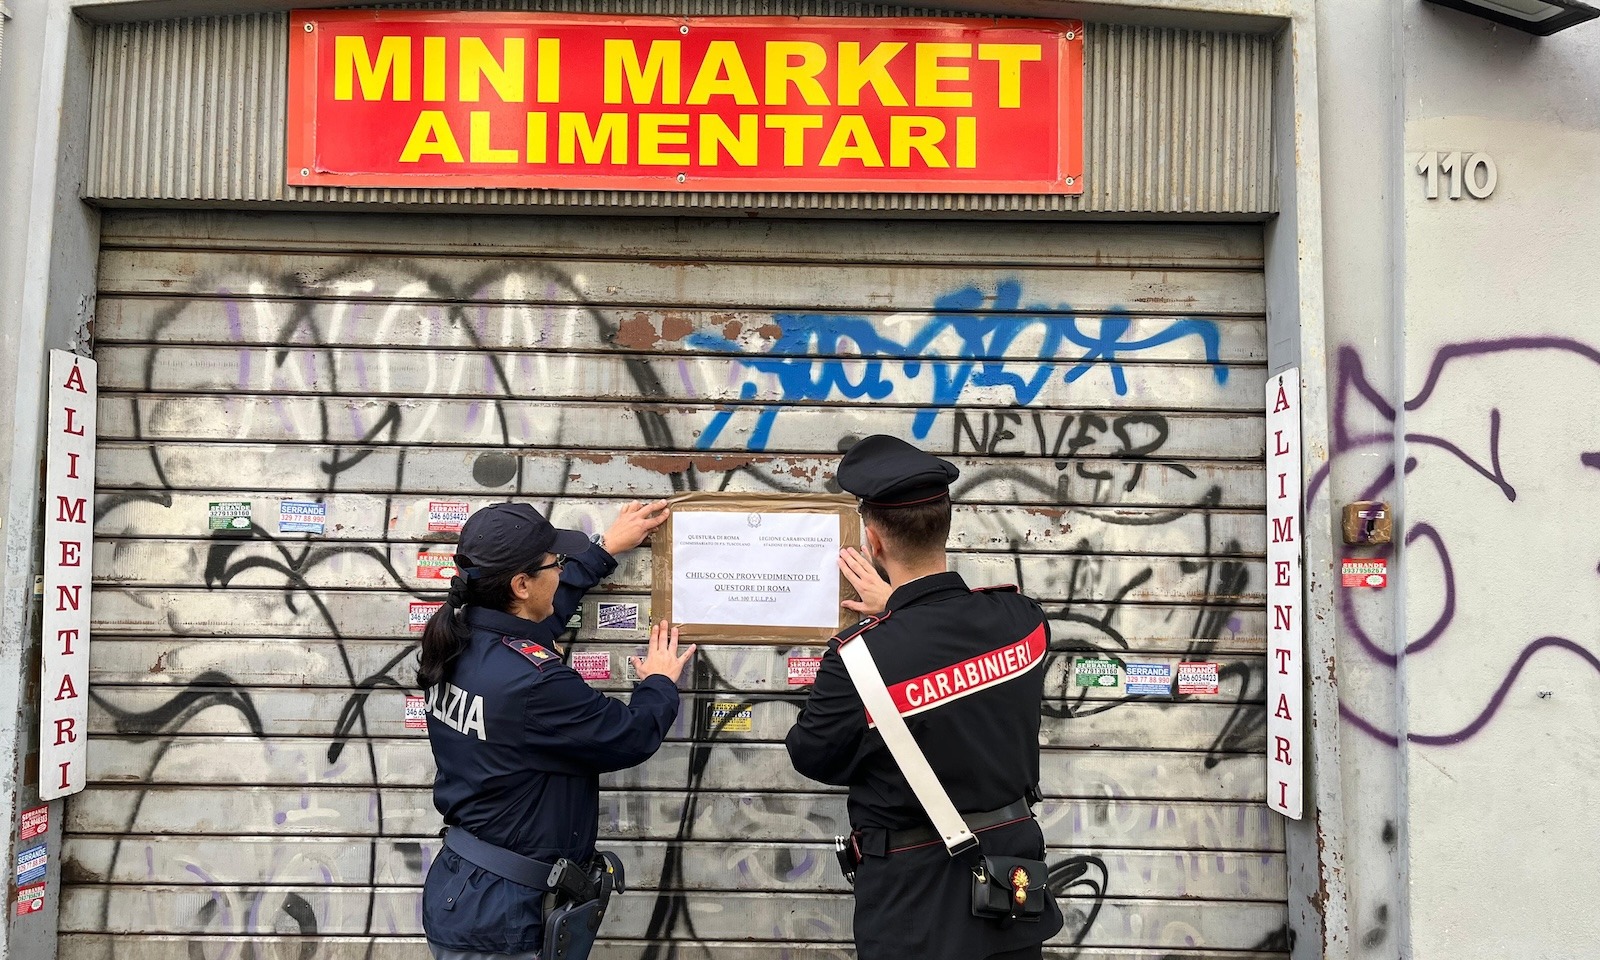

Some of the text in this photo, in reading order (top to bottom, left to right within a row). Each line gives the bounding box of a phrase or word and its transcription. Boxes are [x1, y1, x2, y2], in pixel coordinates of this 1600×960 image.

[333, 35, 1043, 109] MINI MARKET
[398, 109, 978, 169] ALIMENTARI
[1415, 151, 1497, 200] 110
[281, 506, 324, 515] SERRANDE
[430, 512, 441, 520] 346
[54, 365, 88, 789] ALIMENTARI
[685, 571, 716, 579] CHIUSO
[735, 572, 804, 581] PROVVEDIMENTO
[714, 584, 755, 592] QUESTORE
[756, 584, 766, 592] DI
[1271, 386, 1292, 809] ALIMENTARI
[905, 641, 1031, 707] CARABINIERI
[1126, 668, 1169, 676] SERRANDE
[1179, 674, 1190, 682] 346
[21, 806, 48, 821] SERRANDE
[18, 847, 46, 864] SERRANDE
[19, 885, 44, 896] SERRANDE
